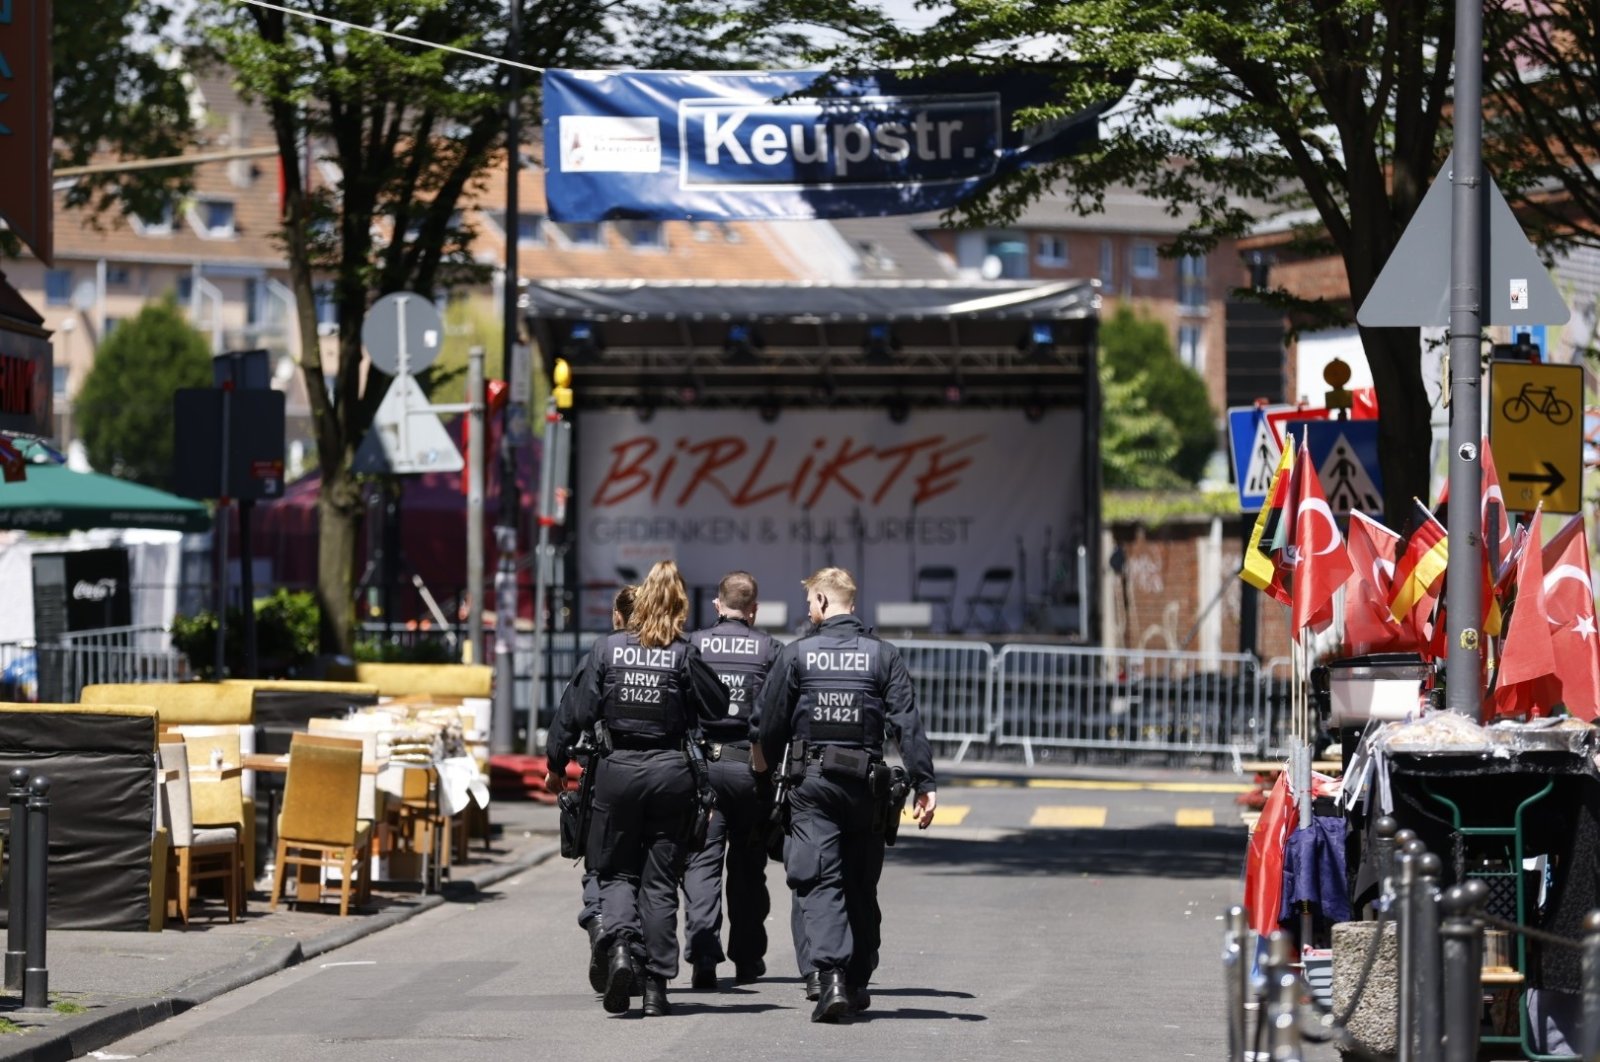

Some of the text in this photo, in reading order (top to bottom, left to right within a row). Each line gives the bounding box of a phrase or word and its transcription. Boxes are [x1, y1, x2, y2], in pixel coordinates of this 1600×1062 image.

[703, 111, 975, 176] Keupstr.
[589, 515, 974, 545] GEDENKEN & KULTURFEST
[701, 637, 759, 655] POLIZEI
[613, 647, 676, 668] POLIZEI
[807, 652, 869, 671] POLIZEI
[624, 672, 660, 687] NRW
[718, 674, 745, 687] RW
[620, 687, 660, 703] 31422
[818, 692, 854, 706] NRW
[813, 706, 859, 722] 31421
